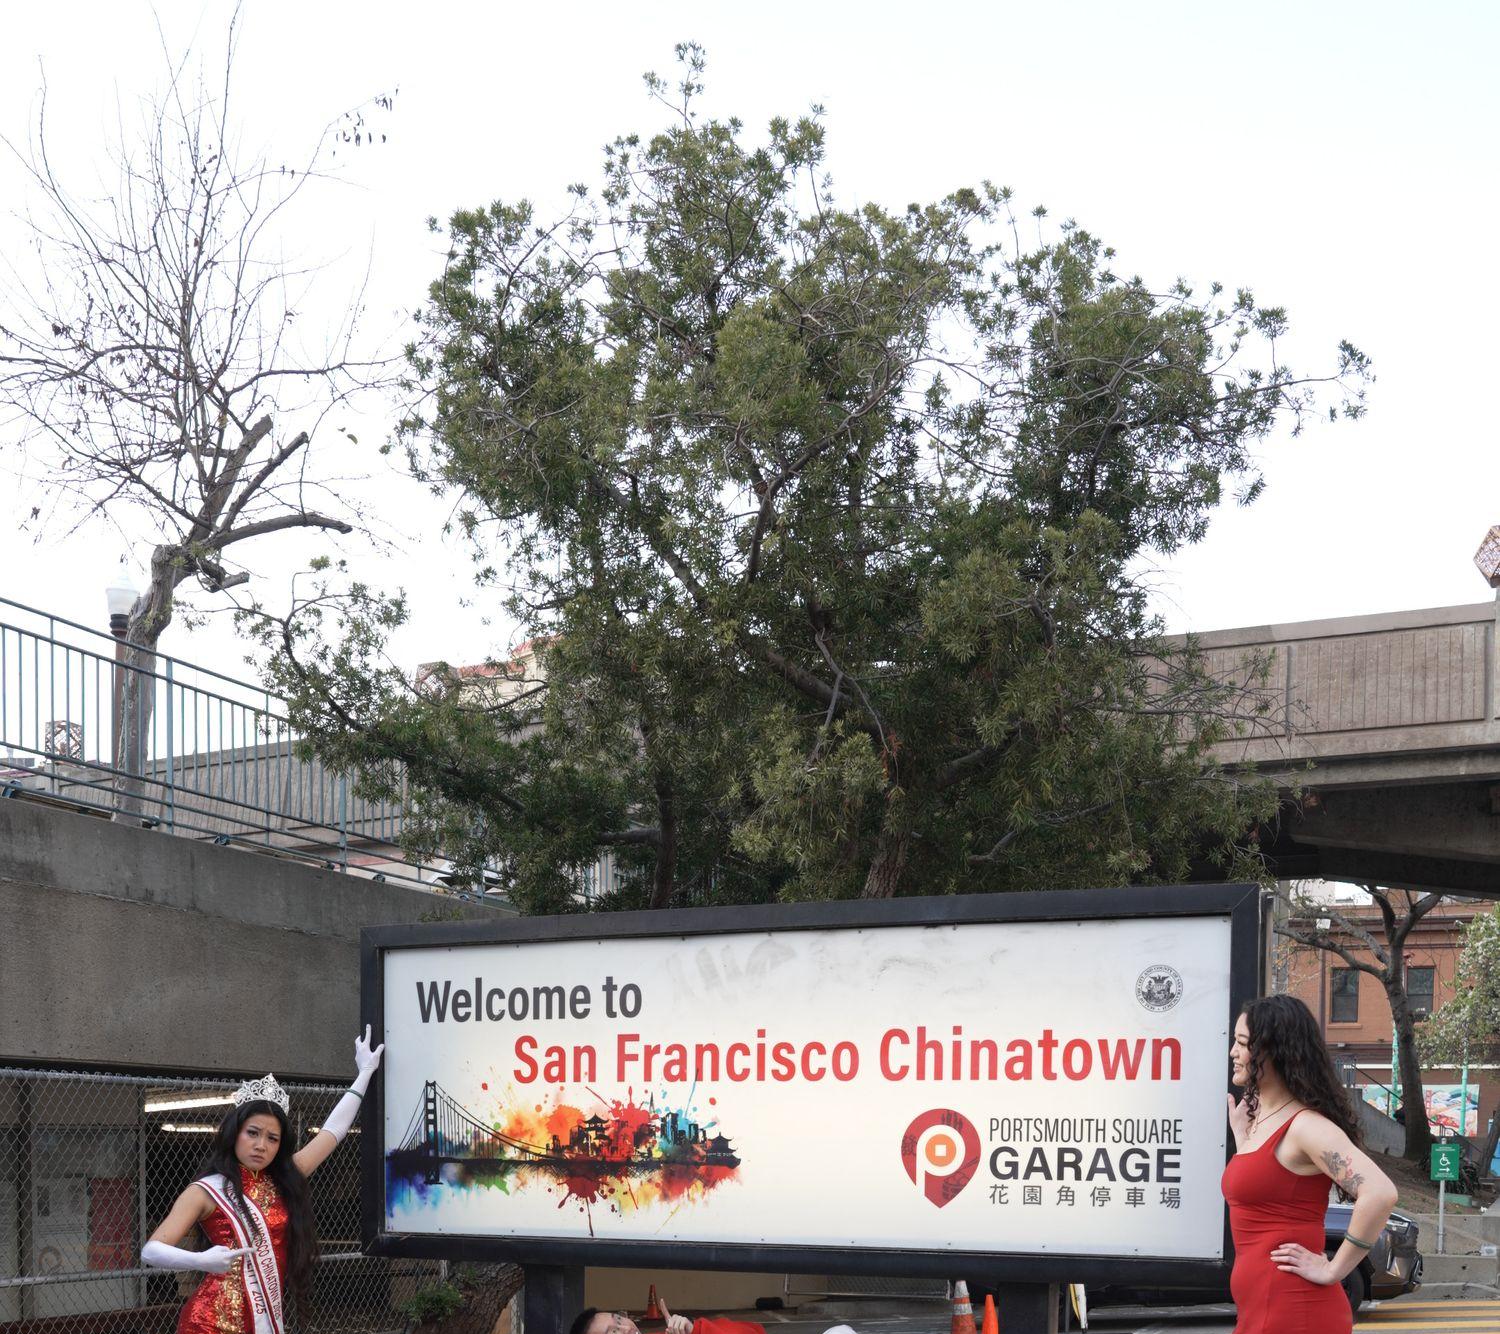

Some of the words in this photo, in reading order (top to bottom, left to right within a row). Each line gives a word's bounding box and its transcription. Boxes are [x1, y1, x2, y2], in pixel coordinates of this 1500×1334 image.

[416, 976, 591, 1024] Welcome
[601, 976, 643, 1019] to
[513, 1035, 597, 1084] San
[616, 1028, 859, 1083] Francisco
[879, 1025, 1182, 1082] Chinatown
[989, 1117, 1106, 1144] PORTSMOUTH
[1111, 1118, 1183, 1146] SQUARE
[989, 1146, 1182, 1184] GARAGE
[989, 1184, 1181, 1210] 花園角停車場
[261, 1257, 280, 1303] CHINATOWN
[252, 1290, 267, 1315] 2025
